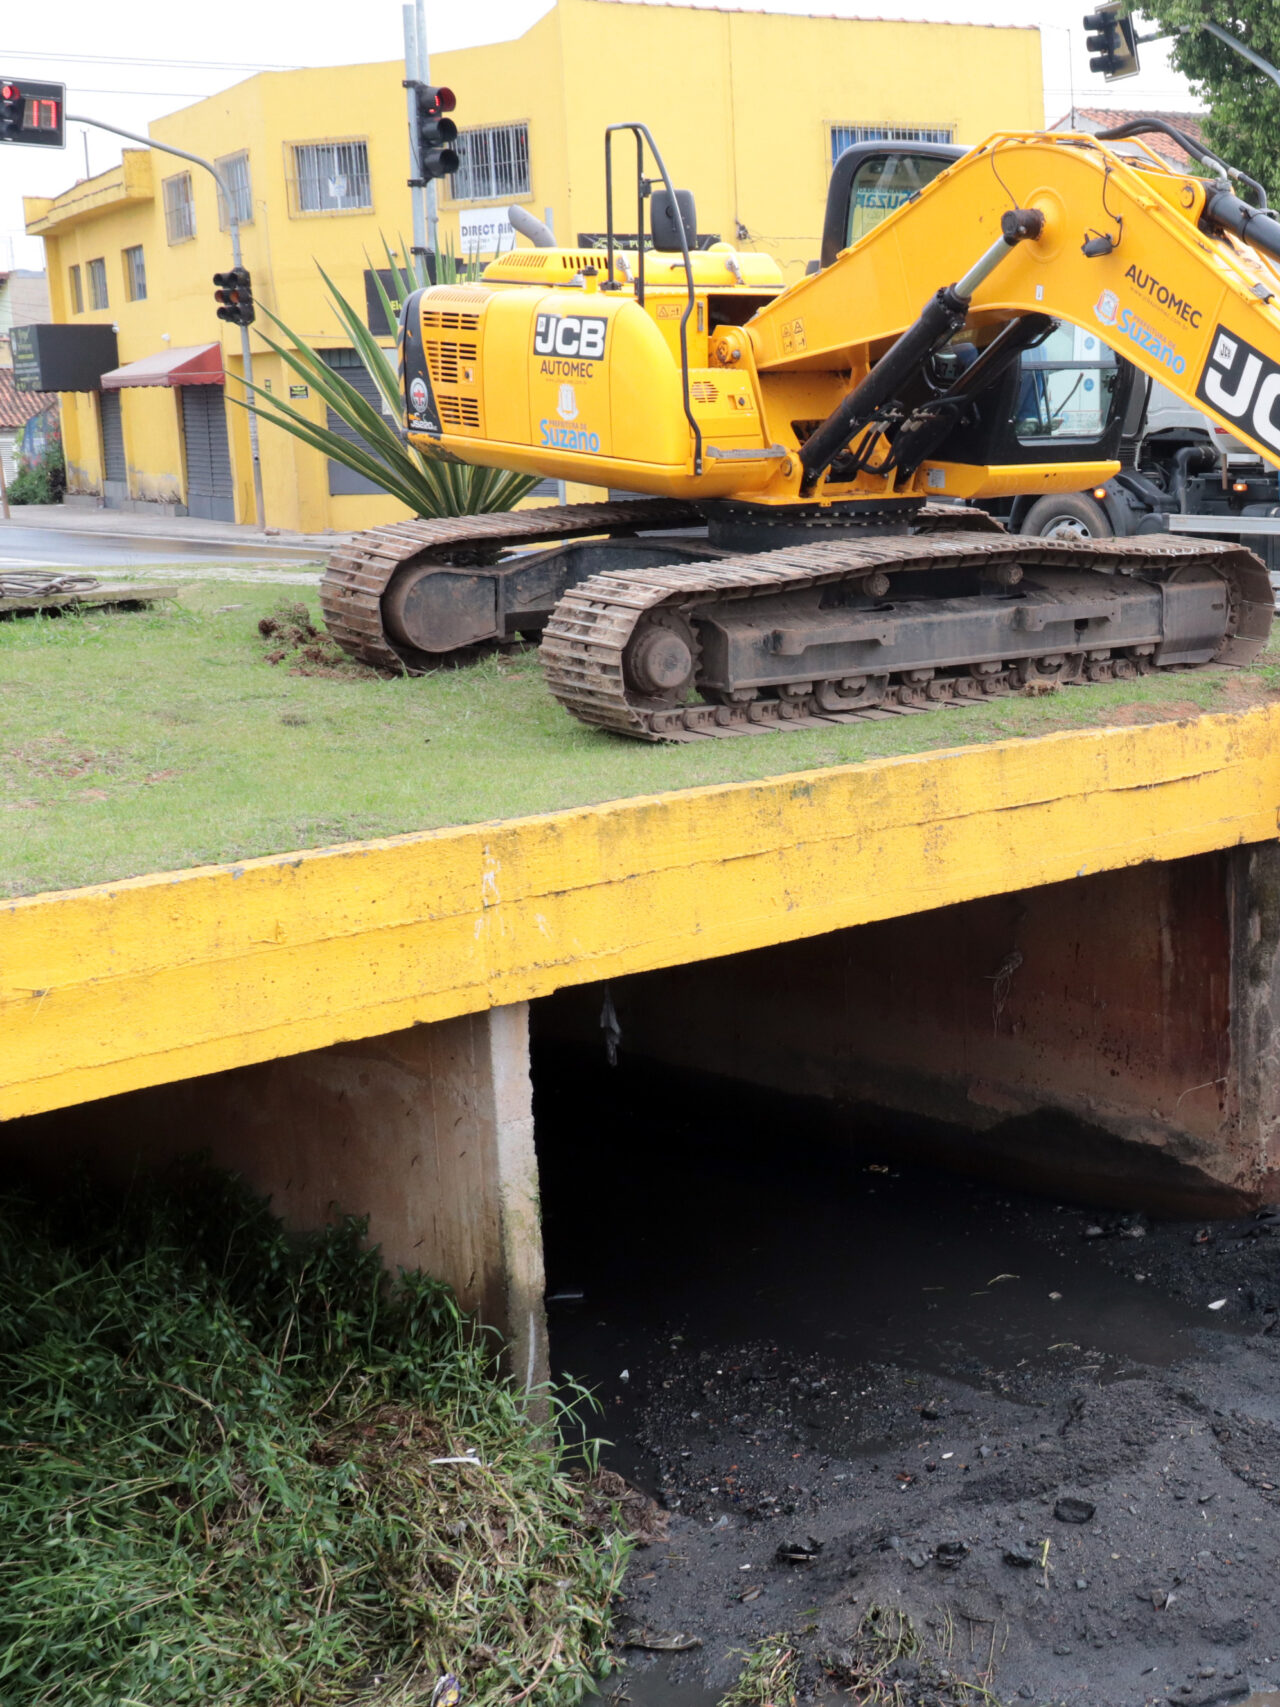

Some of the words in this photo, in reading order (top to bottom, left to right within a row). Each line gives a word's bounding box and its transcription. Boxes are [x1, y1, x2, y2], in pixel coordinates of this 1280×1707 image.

[33, 99, 57, 128] 17
[461, 224, 495, 237] DIRECT
[1125, 264, 1203, 329] AUTOMEC
[535, 317, 606, 357] JCB
[1117, 308, 1187, 375] Suzano
[540, 360, 594, 378] AUTOMEC
[540, 418, 600, 452] Suzano
